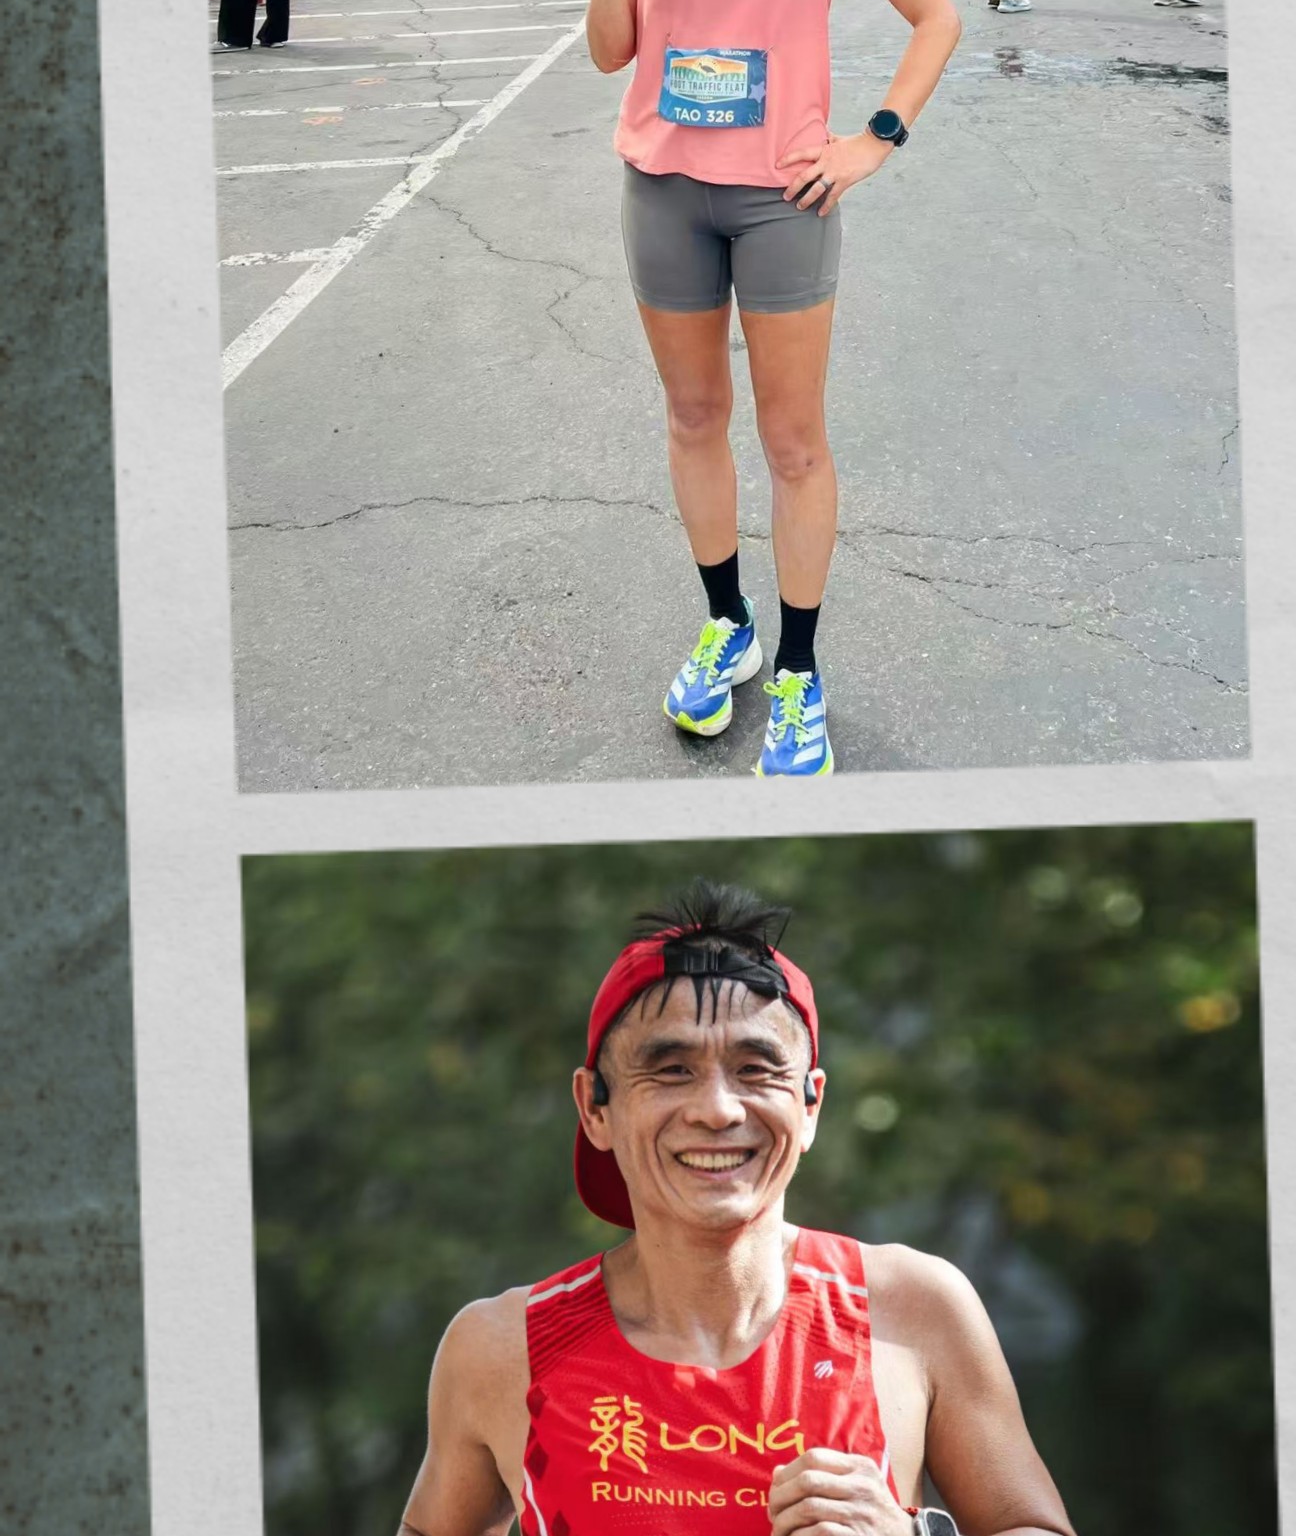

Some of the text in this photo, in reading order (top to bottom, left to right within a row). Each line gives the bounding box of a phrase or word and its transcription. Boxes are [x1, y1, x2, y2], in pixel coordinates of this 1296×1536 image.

[670, 79, 686, 90] FOOT
[689, 81, 722, 92] TRAFFIC
[725, 82, 745, 92] FLAT
[673, 107, 735, 123] TAO 326
[659, 1418, 806, 1456] LONG
[734, 1487, 769, 1507] CL
